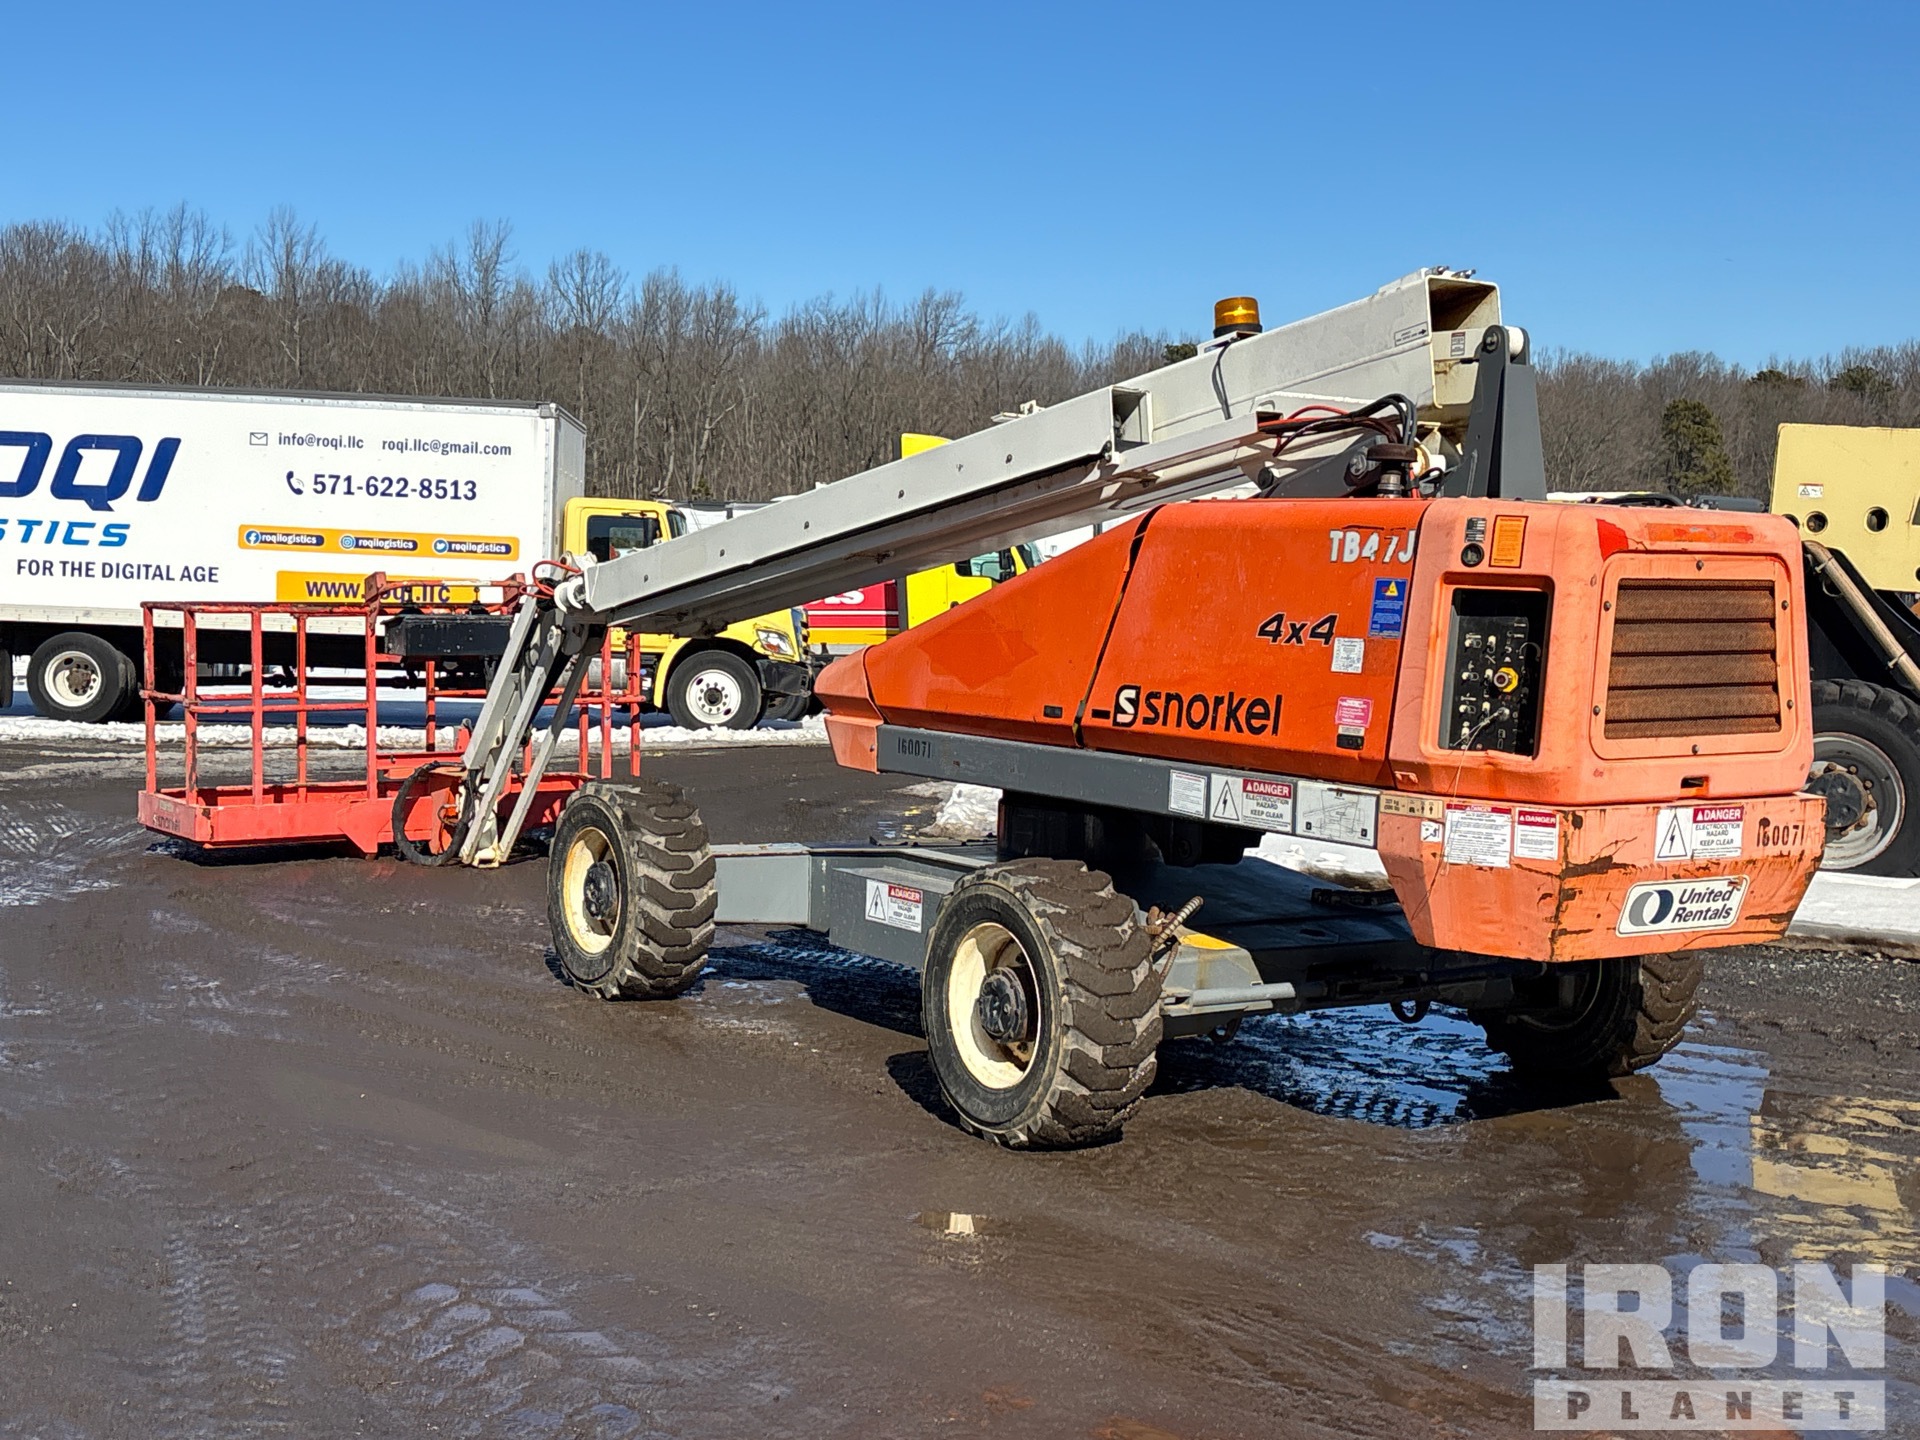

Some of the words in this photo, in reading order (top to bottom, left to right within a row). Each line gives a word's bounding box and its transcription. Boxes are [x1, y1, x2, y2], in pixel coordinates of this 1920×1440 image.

[278, 432, 365, 449] info@roqi.llc
[382, 438, 512, 456] roqi.llc@gmail.com
[312, 473, 477, 501] 571-622-8513
[0, 518, 131, 547] TICS
[262, 532, 317, 546] roqilogistics
[358, 537, 414, 550] roqilogistics
[451, 541, 506, 554] roqilogistics
[1329, 529, 1415, 564] TB47J
[17, 559, 54, 576] FOR
[59, 560, 96, 578] THE
[101, 562, 175, 581] DIGITAL
[179, 565, 219, 583] AGE
[1256, 612, 1339, 647] 4x4
[1141, 690, 1284, 737] snorkel
[897, 736, 932, 759] 160071
[1254, 783, 1290, 797] DANGER
[1245, 794, 1289, 806] ELECTROCUTION
[1256, 801, 1279, 810] HAZARD
[1250, 809, 1264, 817] KEEP
[1265, 811, 1284, 820] CLEAR
[1525, 814, 1556, 824] DANGER
[1703, 808, 1741, 821] DANGER
[1695, 823, 1741, 831] ELECTROCUTION
[1706, 829, 1729, 837] HAZARD
[1756, 821, 1805, 848] 160071
[1700, 839, 1715, 847] KEEP
[1715, 838, 1734, 846] CLEAR
[894, 888, 921, 903] DANGER
[1678, 885, 1736, 905] United
[1670, 904, 1733, 924] Rentals
